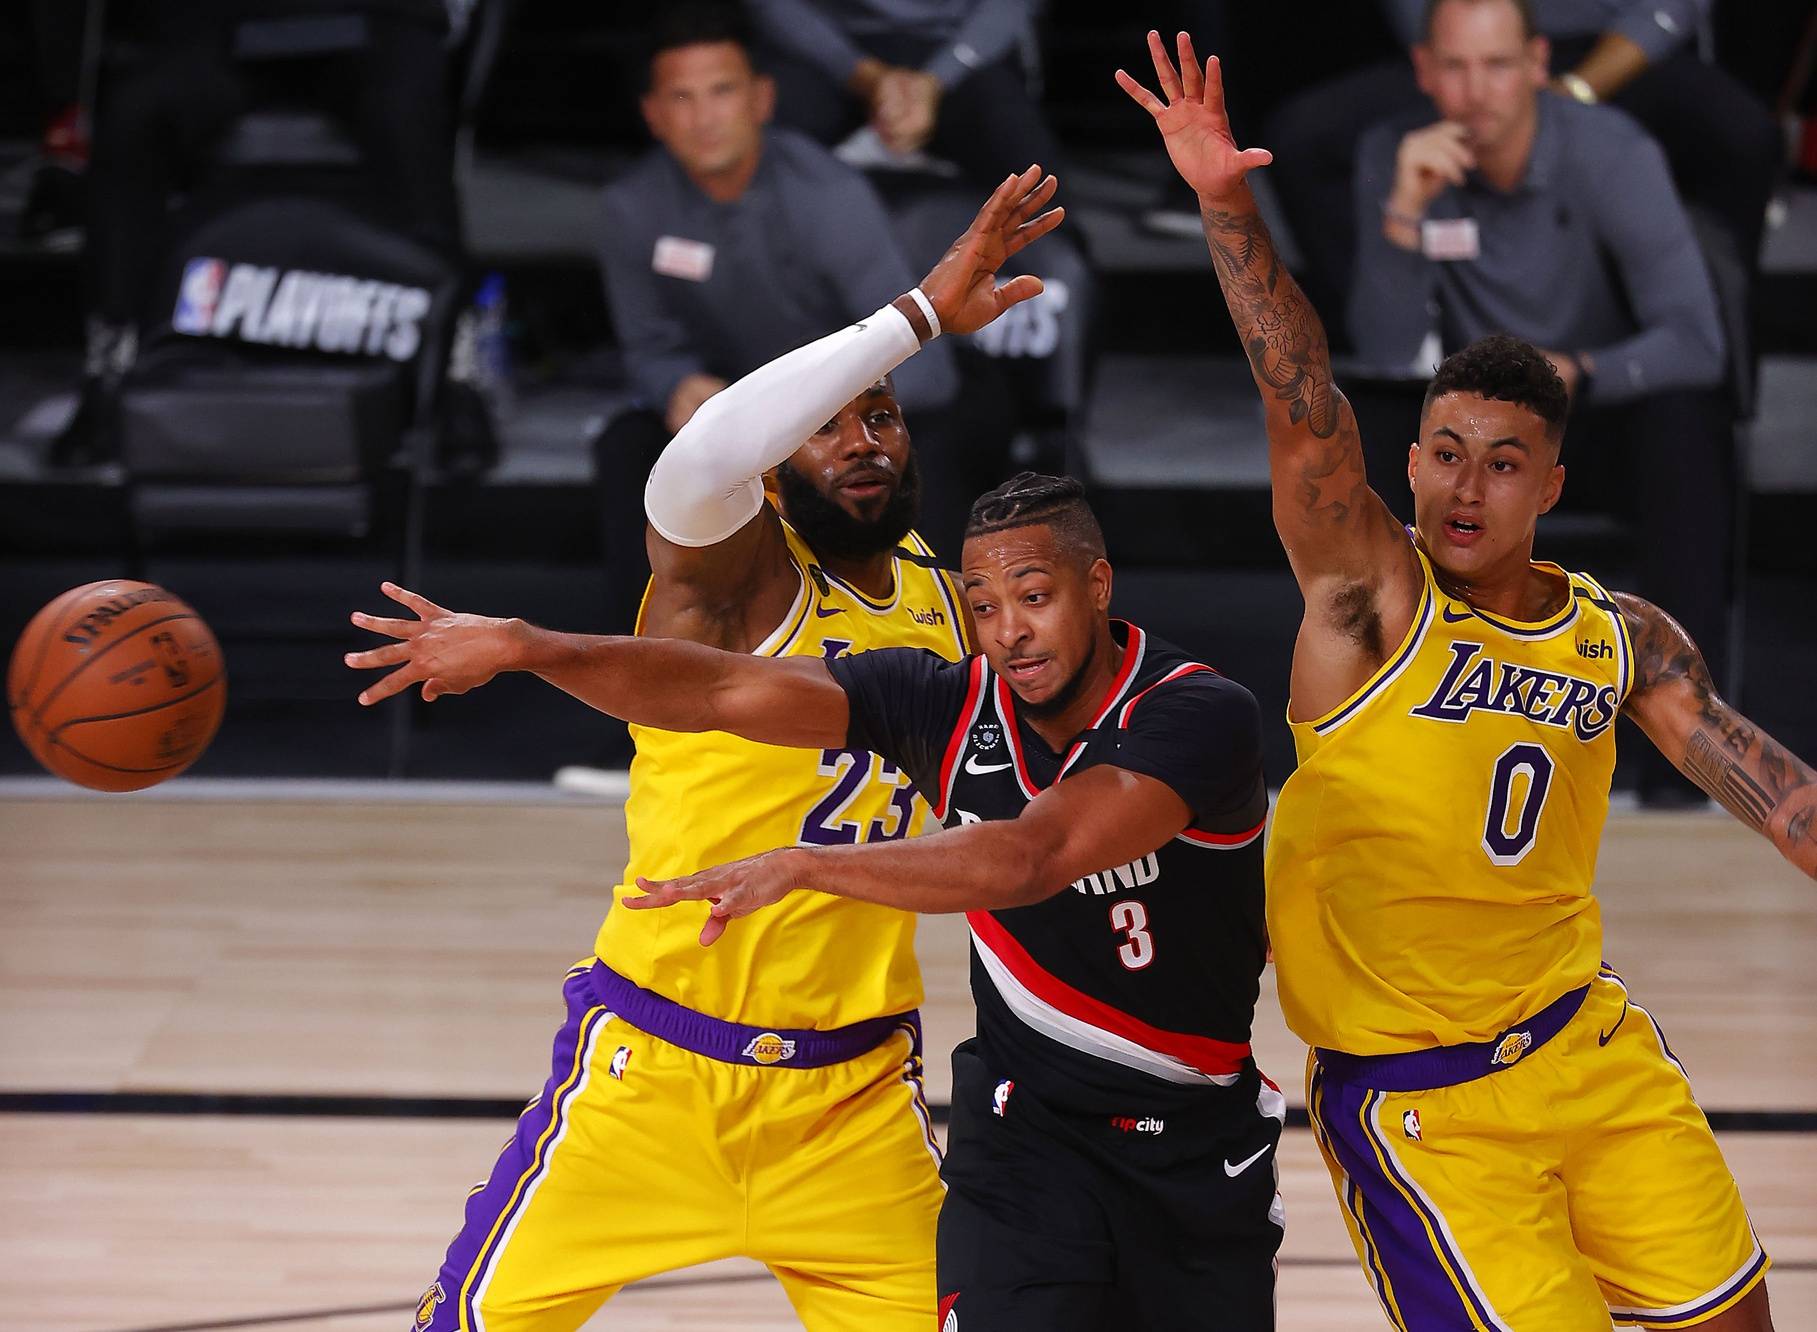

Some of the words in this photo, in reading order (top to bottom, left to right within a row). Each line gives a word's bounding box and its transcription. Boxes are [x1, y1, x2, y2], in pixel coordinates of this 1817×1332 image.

[213, 262, 431, 362] PLAYOFFS
[907, 607, 945, 626] wish
[1408, 640, 1618, 743] LAKERS
[796, 748, 923, 848] 23
[1481, 740, 1556, 867] 0
[1109, 900, 1159, 972] 3
